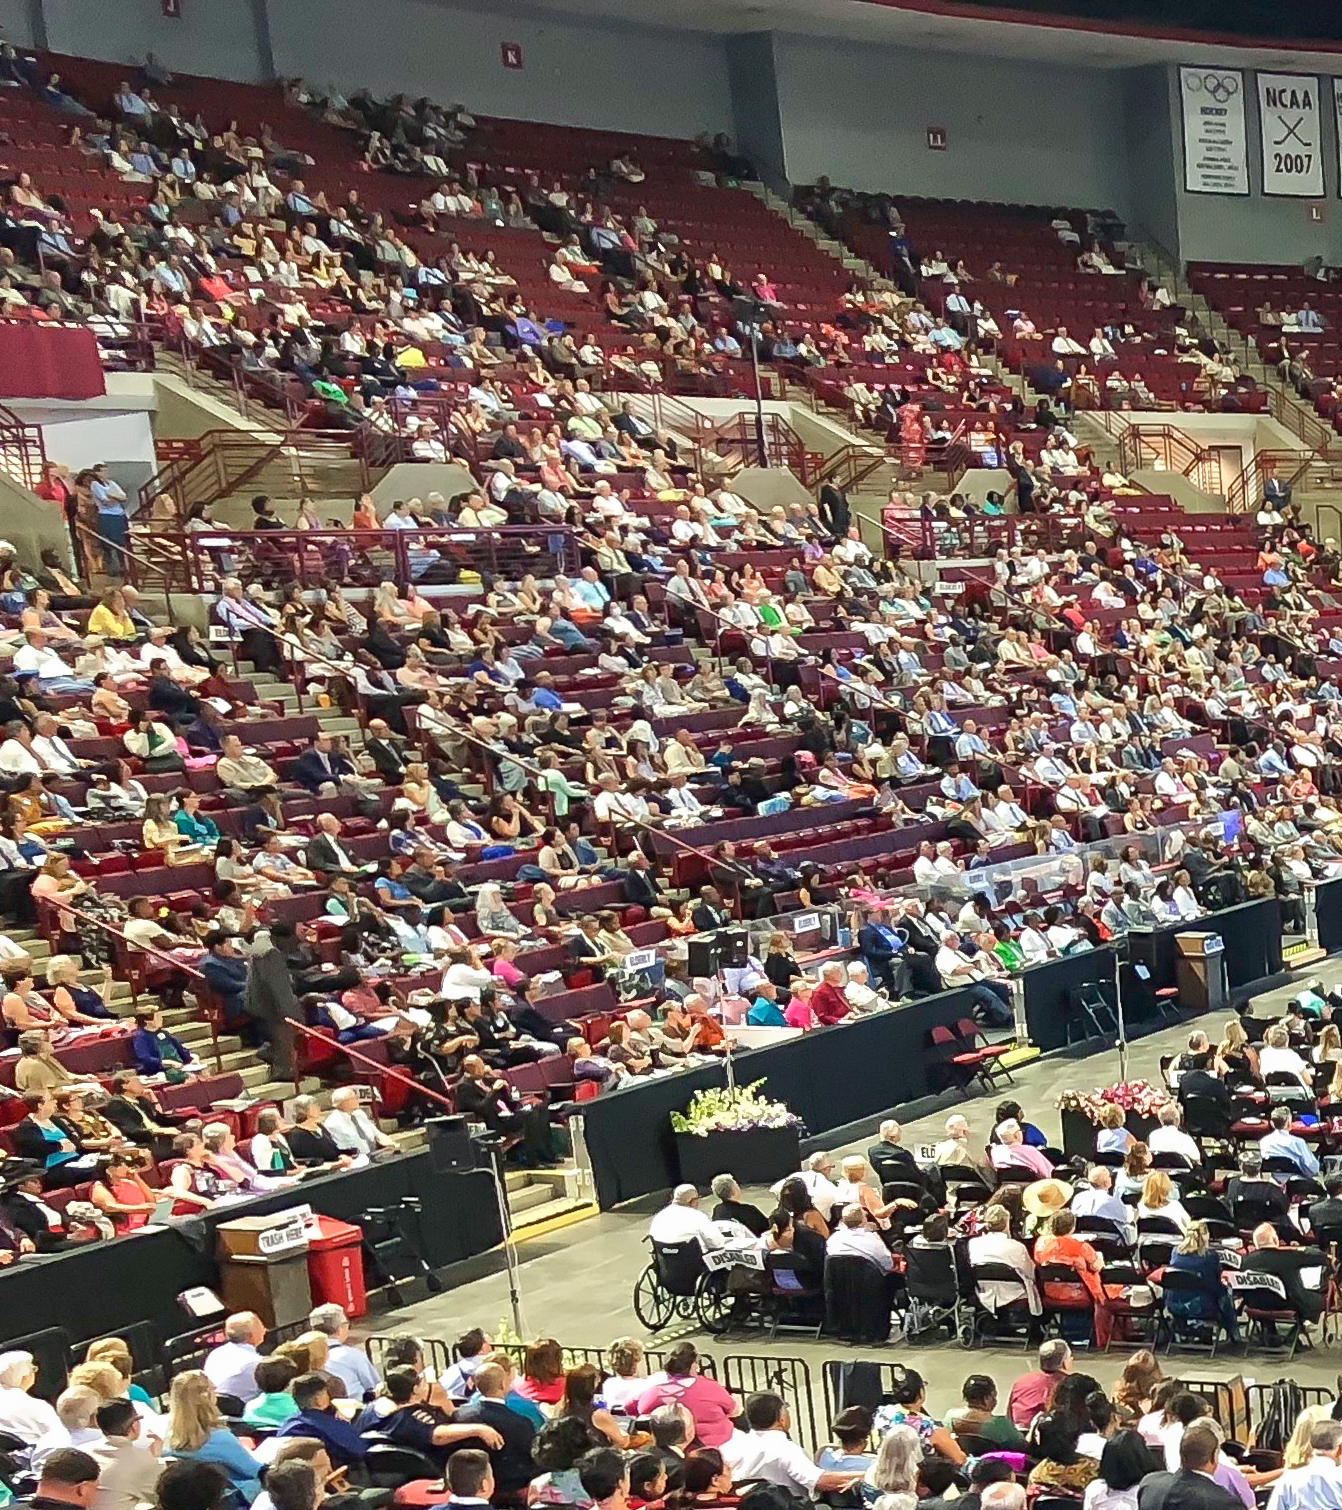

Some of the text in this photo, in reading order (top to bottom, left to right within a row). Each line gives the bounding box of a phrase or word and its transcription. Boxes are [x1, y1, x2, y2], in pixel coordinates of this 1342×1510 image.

[1265, 87, 1312, 110] NCAA
[1273, 152, 1312, 174] 2007
[711, 1252, 758, 1266] DISABLED
[1235, 1273, 1281, 1292] DISABLED
